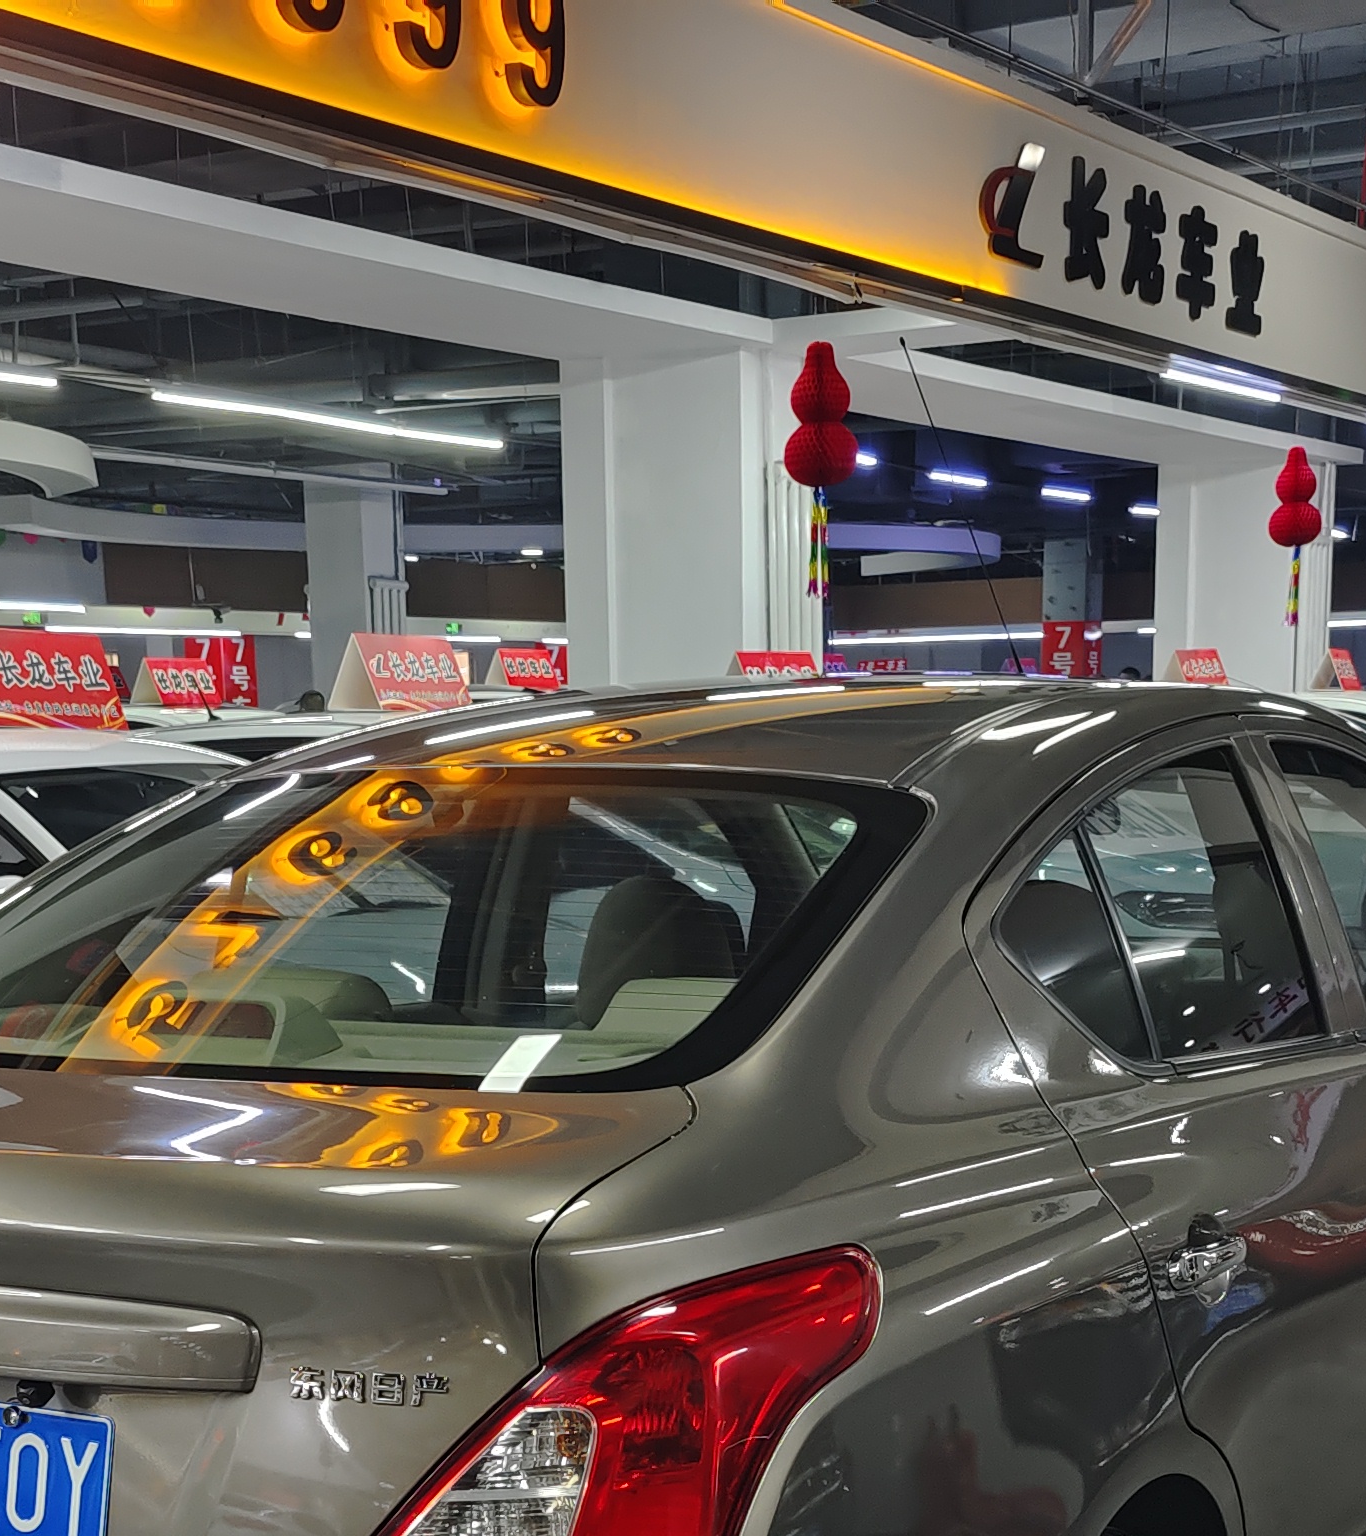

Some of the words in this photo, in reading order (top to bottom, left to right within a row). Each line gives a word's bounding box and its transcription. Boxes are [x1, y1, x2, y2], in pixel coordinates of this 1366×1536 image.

[1064, 156, 1265, 337] 长龙车业
[153, 668, 216, 695] 长龙车业
[388, 650, 461, 684] 长龙车业
[503, 657, 553, 679] 长龙车业
[289, 1366, 449, 1407] 东风日产
